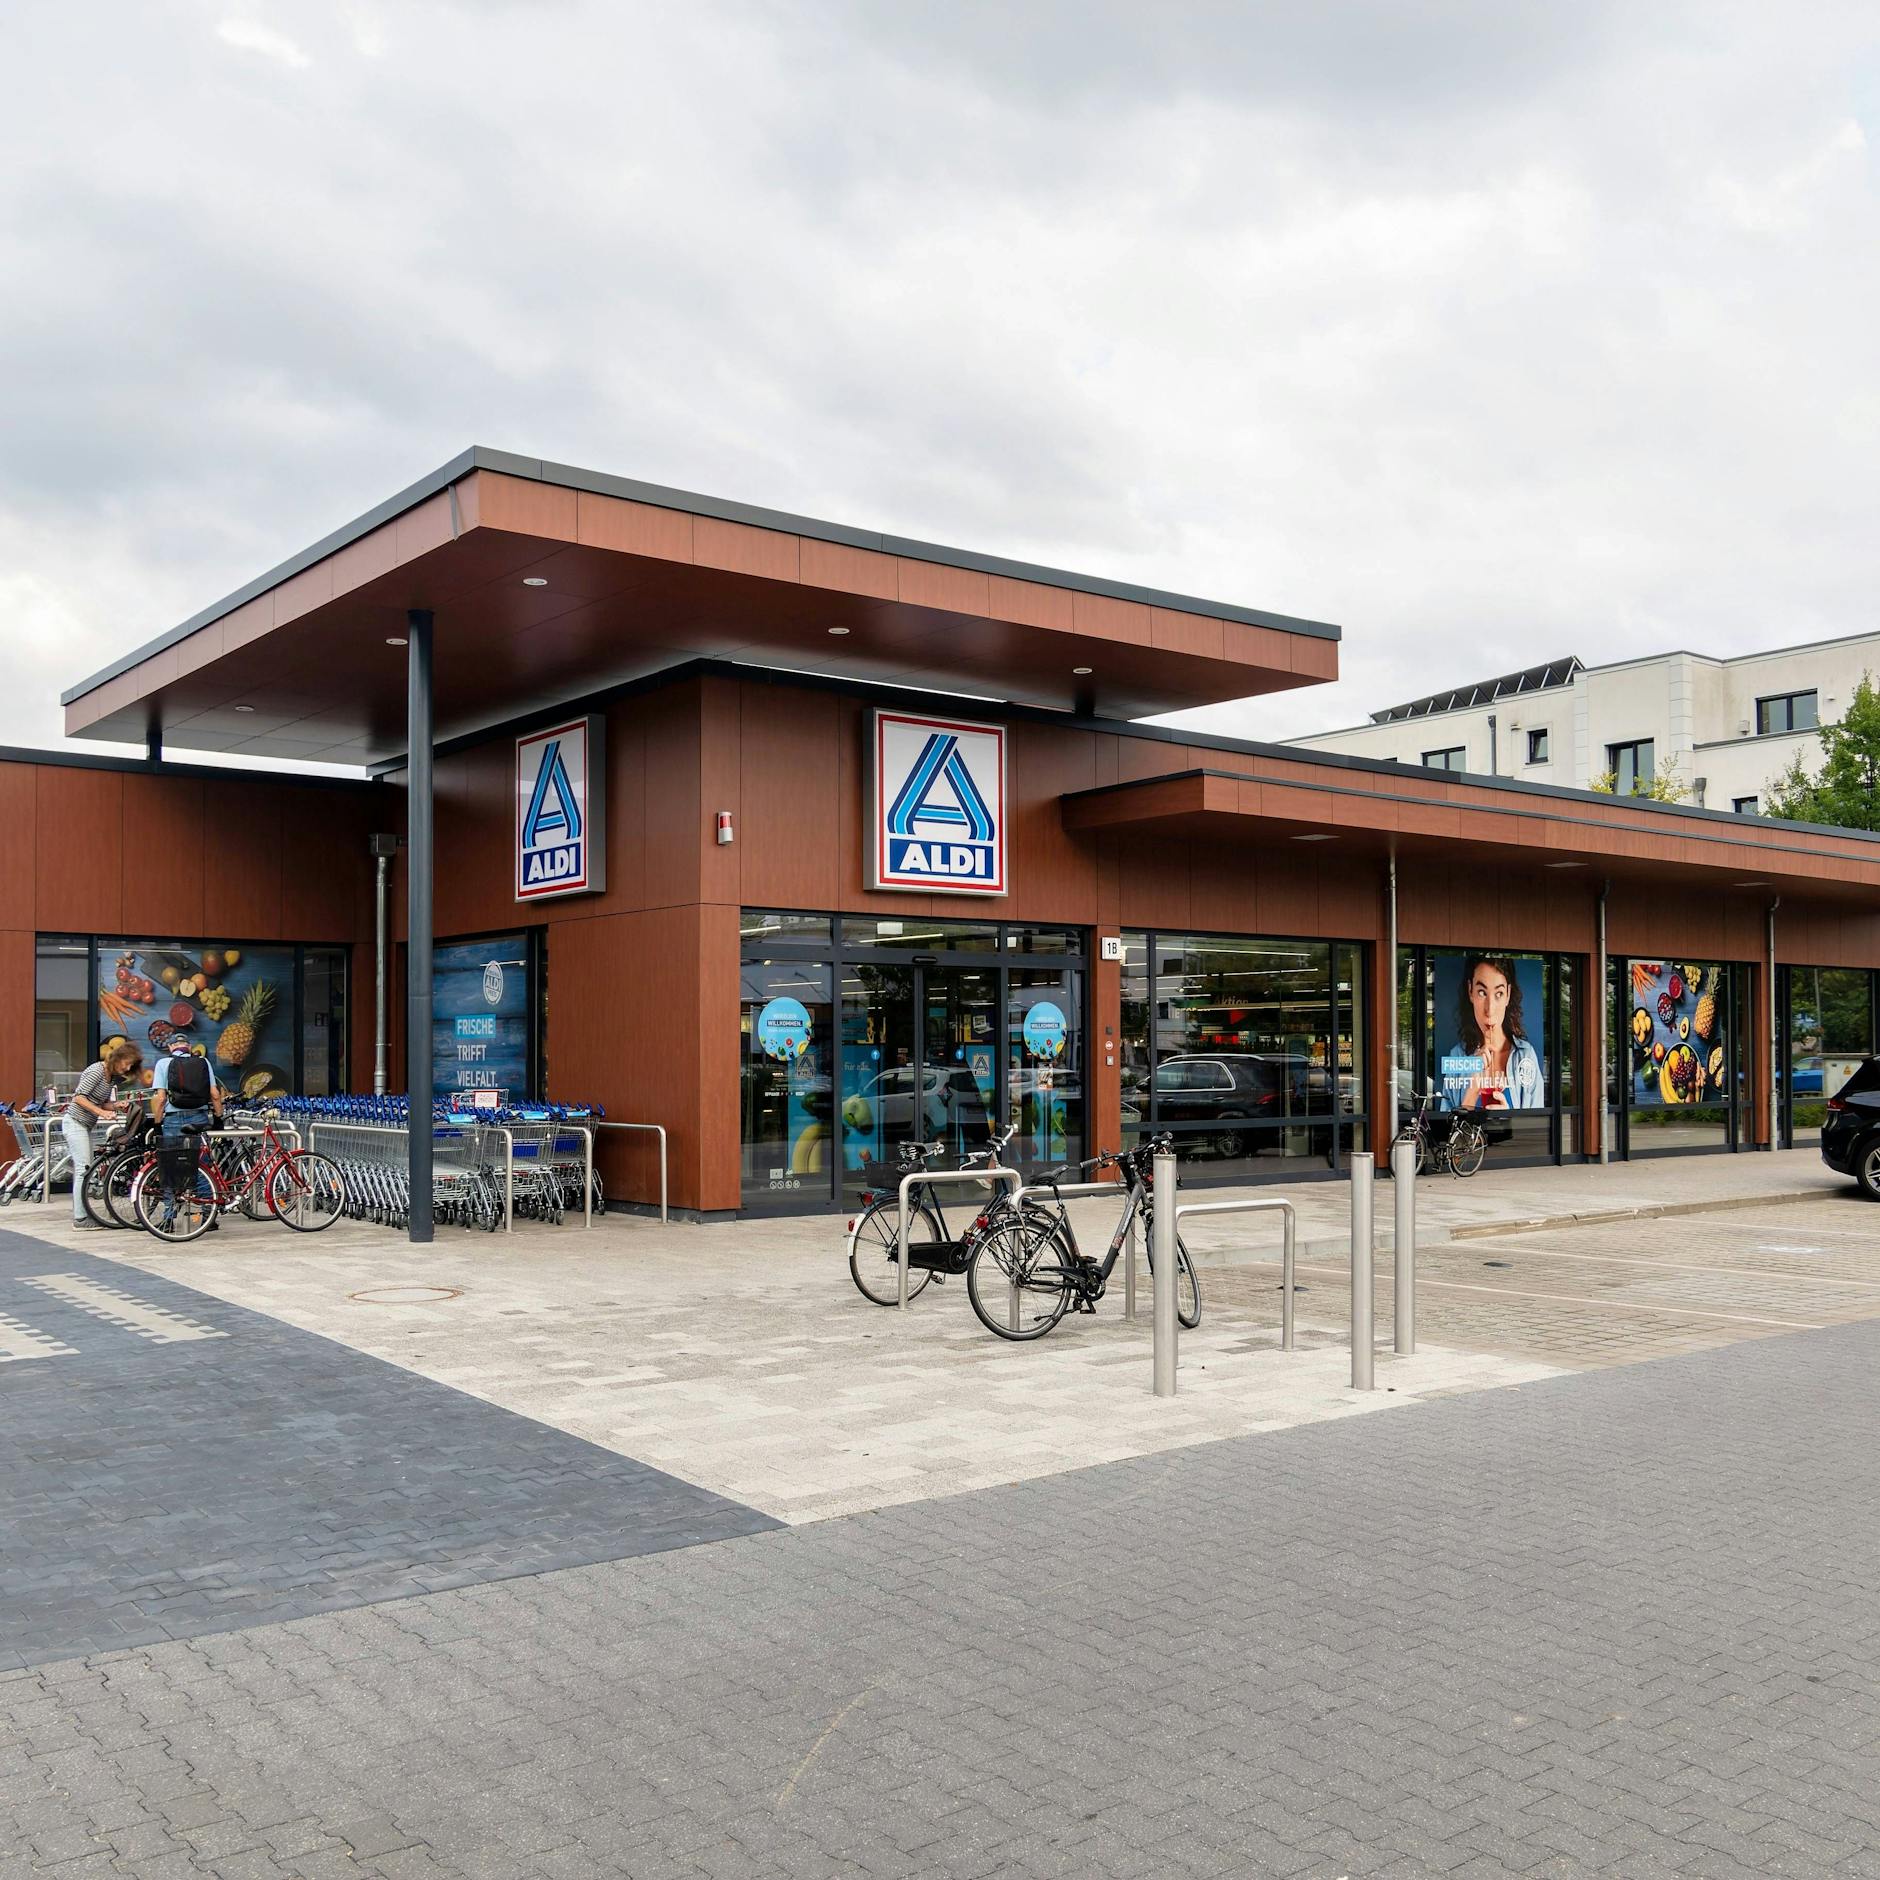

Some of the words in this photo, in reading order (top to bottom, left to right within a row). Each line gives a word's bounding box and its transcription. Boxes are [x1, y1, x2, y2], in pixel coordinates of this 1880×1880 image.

[527, 846, 577, 882] ALDI
[899, 843, 986, 876] ALDI
[1107, 942, 1118, 955] 1B
[457, 1017, 494, 1036] FRISCHE
[456, 1044, 487, 1061] TRIFFT
[1444, 1059, 1481, 1071] FRISCHE
[456, 1070, 498, 1088] VIELFALT.
[1444, 1077, 1473, 1089] TRIFFT
